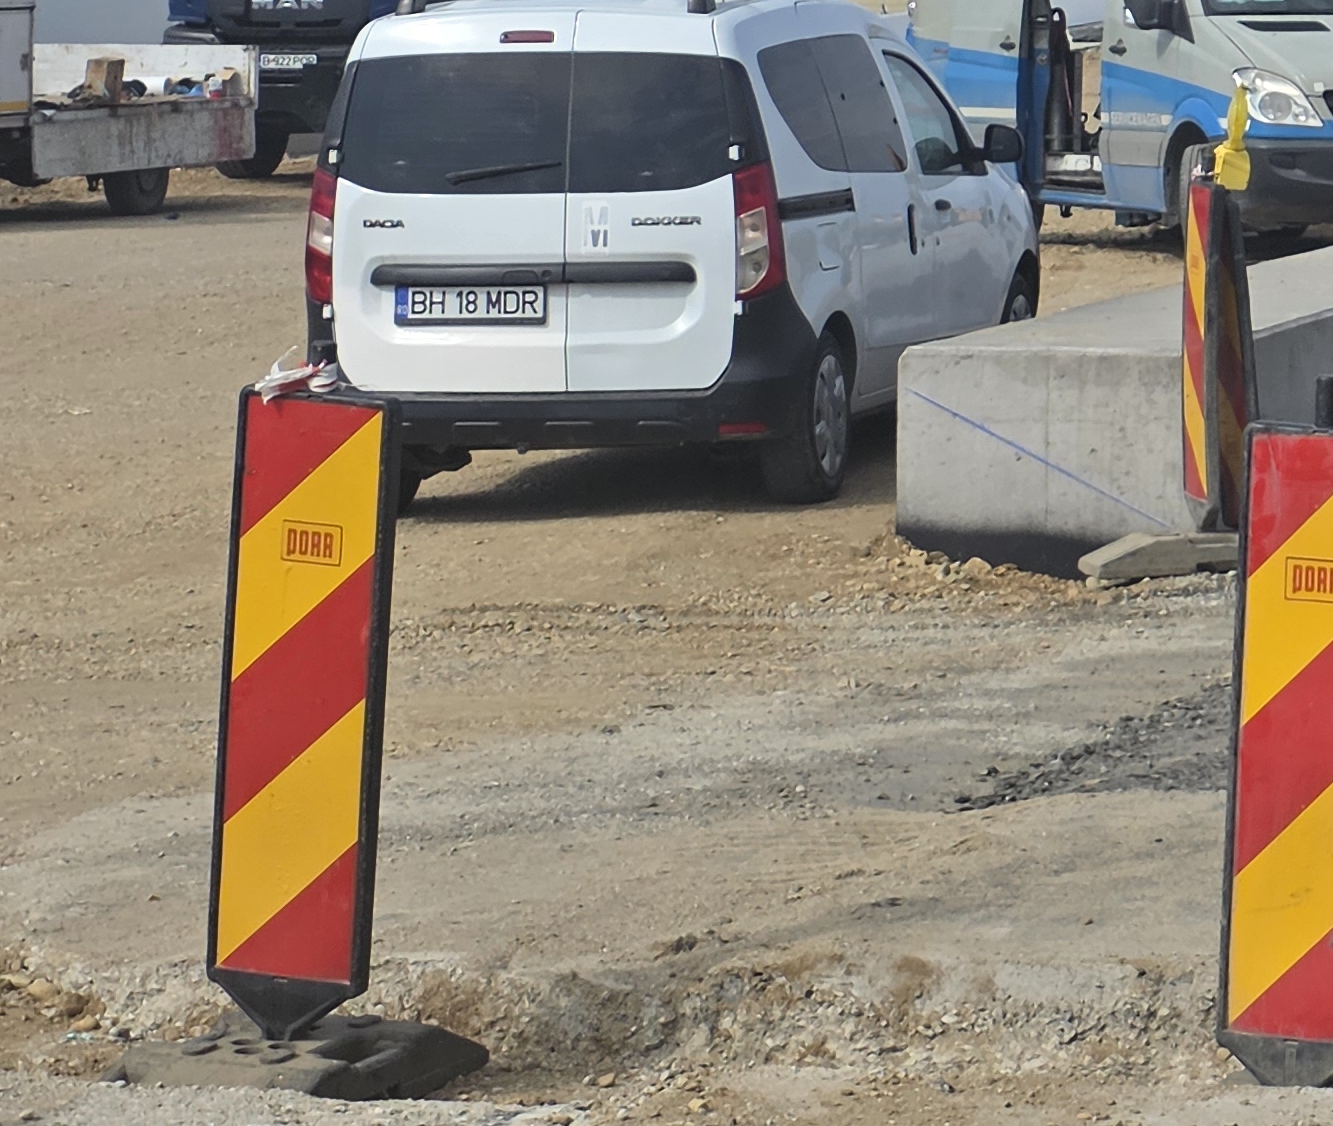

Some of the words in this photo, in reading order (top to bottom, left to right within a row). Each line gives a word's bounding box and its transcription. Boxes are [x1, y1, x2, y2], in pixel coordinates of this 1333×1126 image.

[631, 216, 702, 226] DOKKER
[411, 290, 446, 314] BH
[456, 290, 479, 314] 18
[486, 290, 539, 314] MDR
